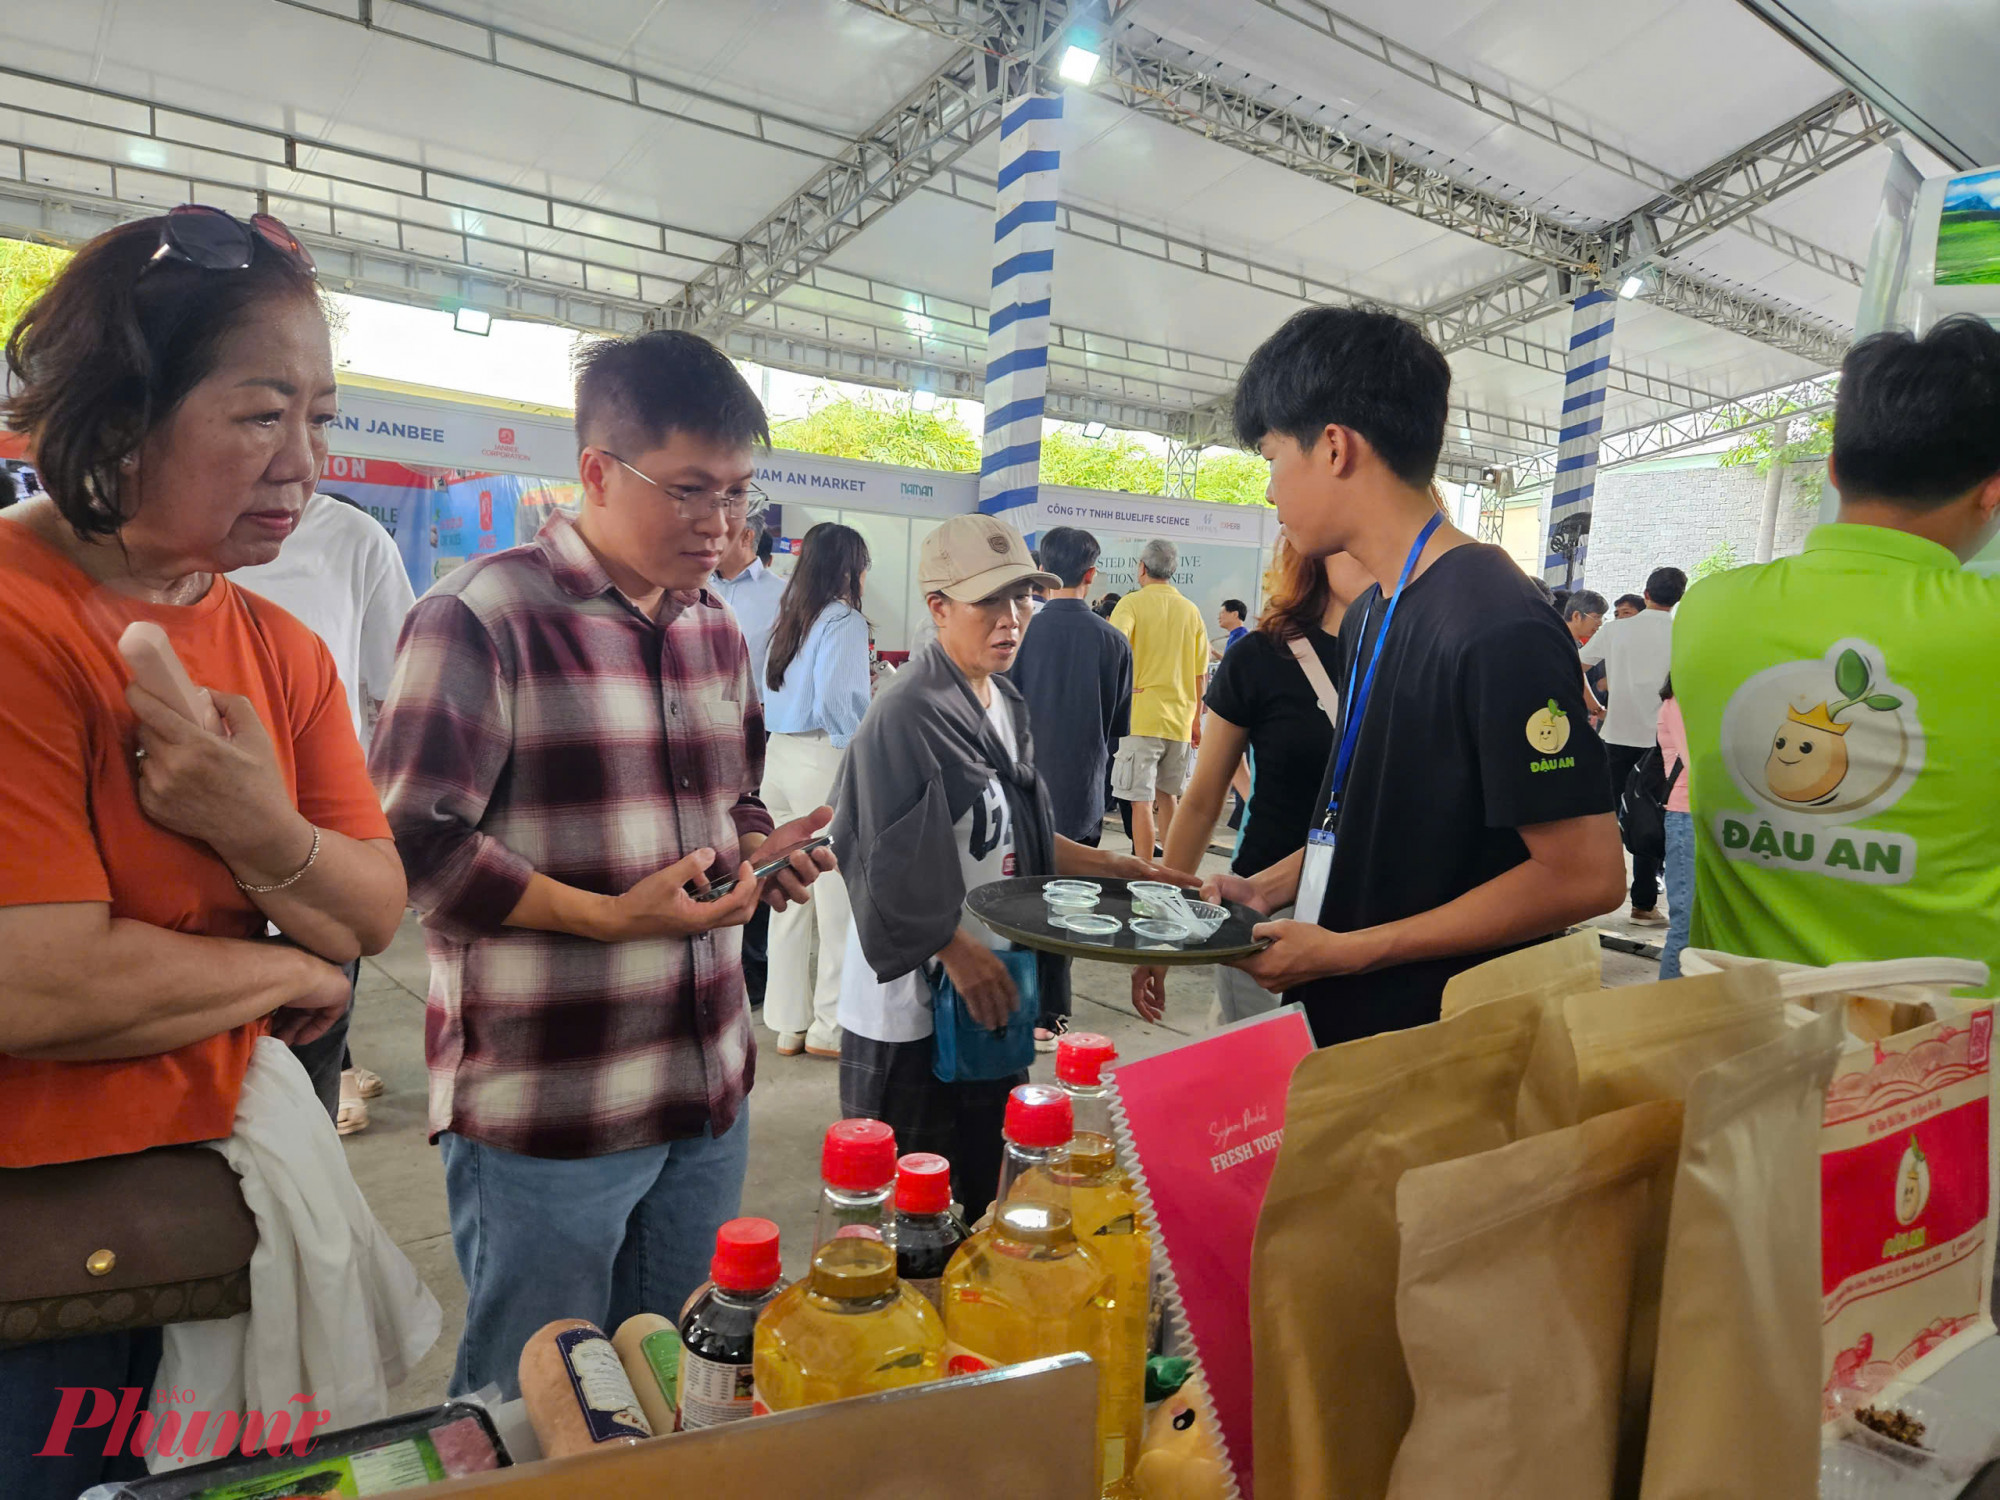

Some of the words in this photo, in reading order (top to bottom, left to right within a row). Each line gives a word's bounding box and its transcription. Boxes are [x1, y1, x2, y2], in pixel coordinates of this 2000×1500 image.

[325, 408, 359, 431] ẦN
[366, 419, 445, 443] JANBEE
[786, 472, 807, 485] AN
[811, 475, 866, 492] MARKET
[1047, 503, 1074, 516] CÔNG
[1076, 507, 1088, 517] TY
[1089, 509, 1114, 520] TNHH
[1115, 511, 1155, 523] BLUELIFE
[1156, 515, 1190, 526] SCIENCE
[1530, 758, 1557, 773] ĐẬU
[1558, 756, 1575, 769] AN
[1722, 818, 1815, 862] ĐẬU
[1824, 838, 1903, 875] AN
[1210, 1142, 1255, 1173] FRESH
